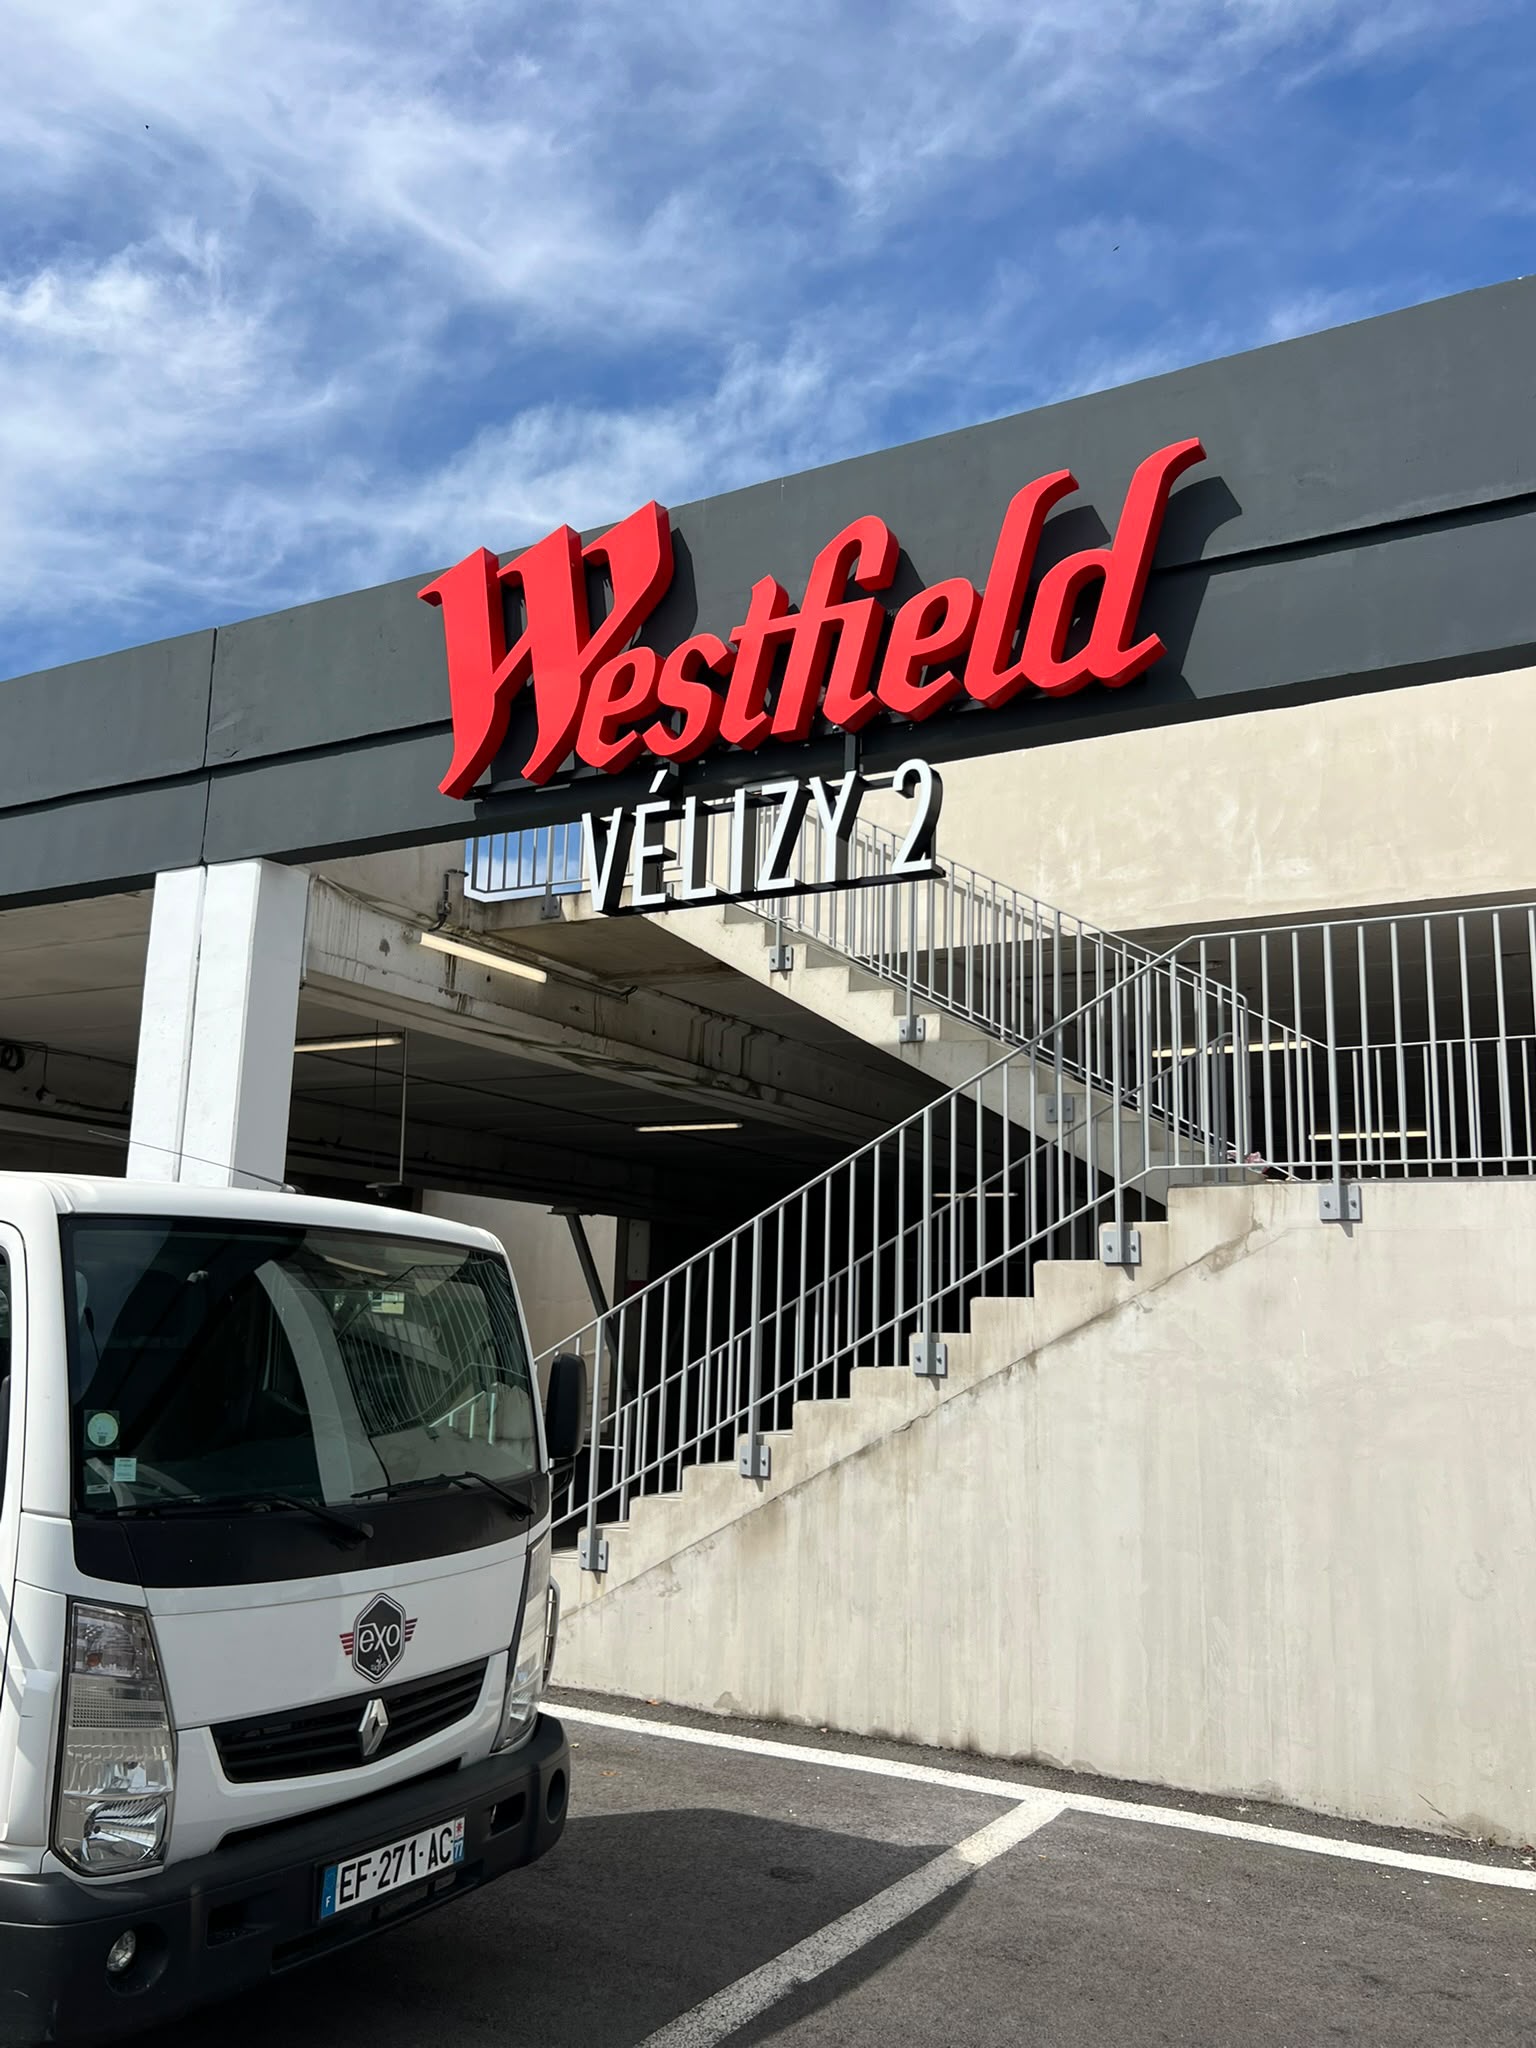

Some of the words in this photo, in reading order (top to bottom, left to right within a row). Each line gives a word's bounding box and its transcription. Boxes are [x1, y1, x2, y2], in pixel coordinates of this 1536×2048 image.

[418, 436, 1206, 799] Westfield
[582, 769, 860, 914] VÉLIZY
[891, 757, 939, 874] 2
[325, 1895, 332, 1909] F
[339, 1827, 453, 1905] EF-271-AC
[453, 1840, 464, 1860] 77
